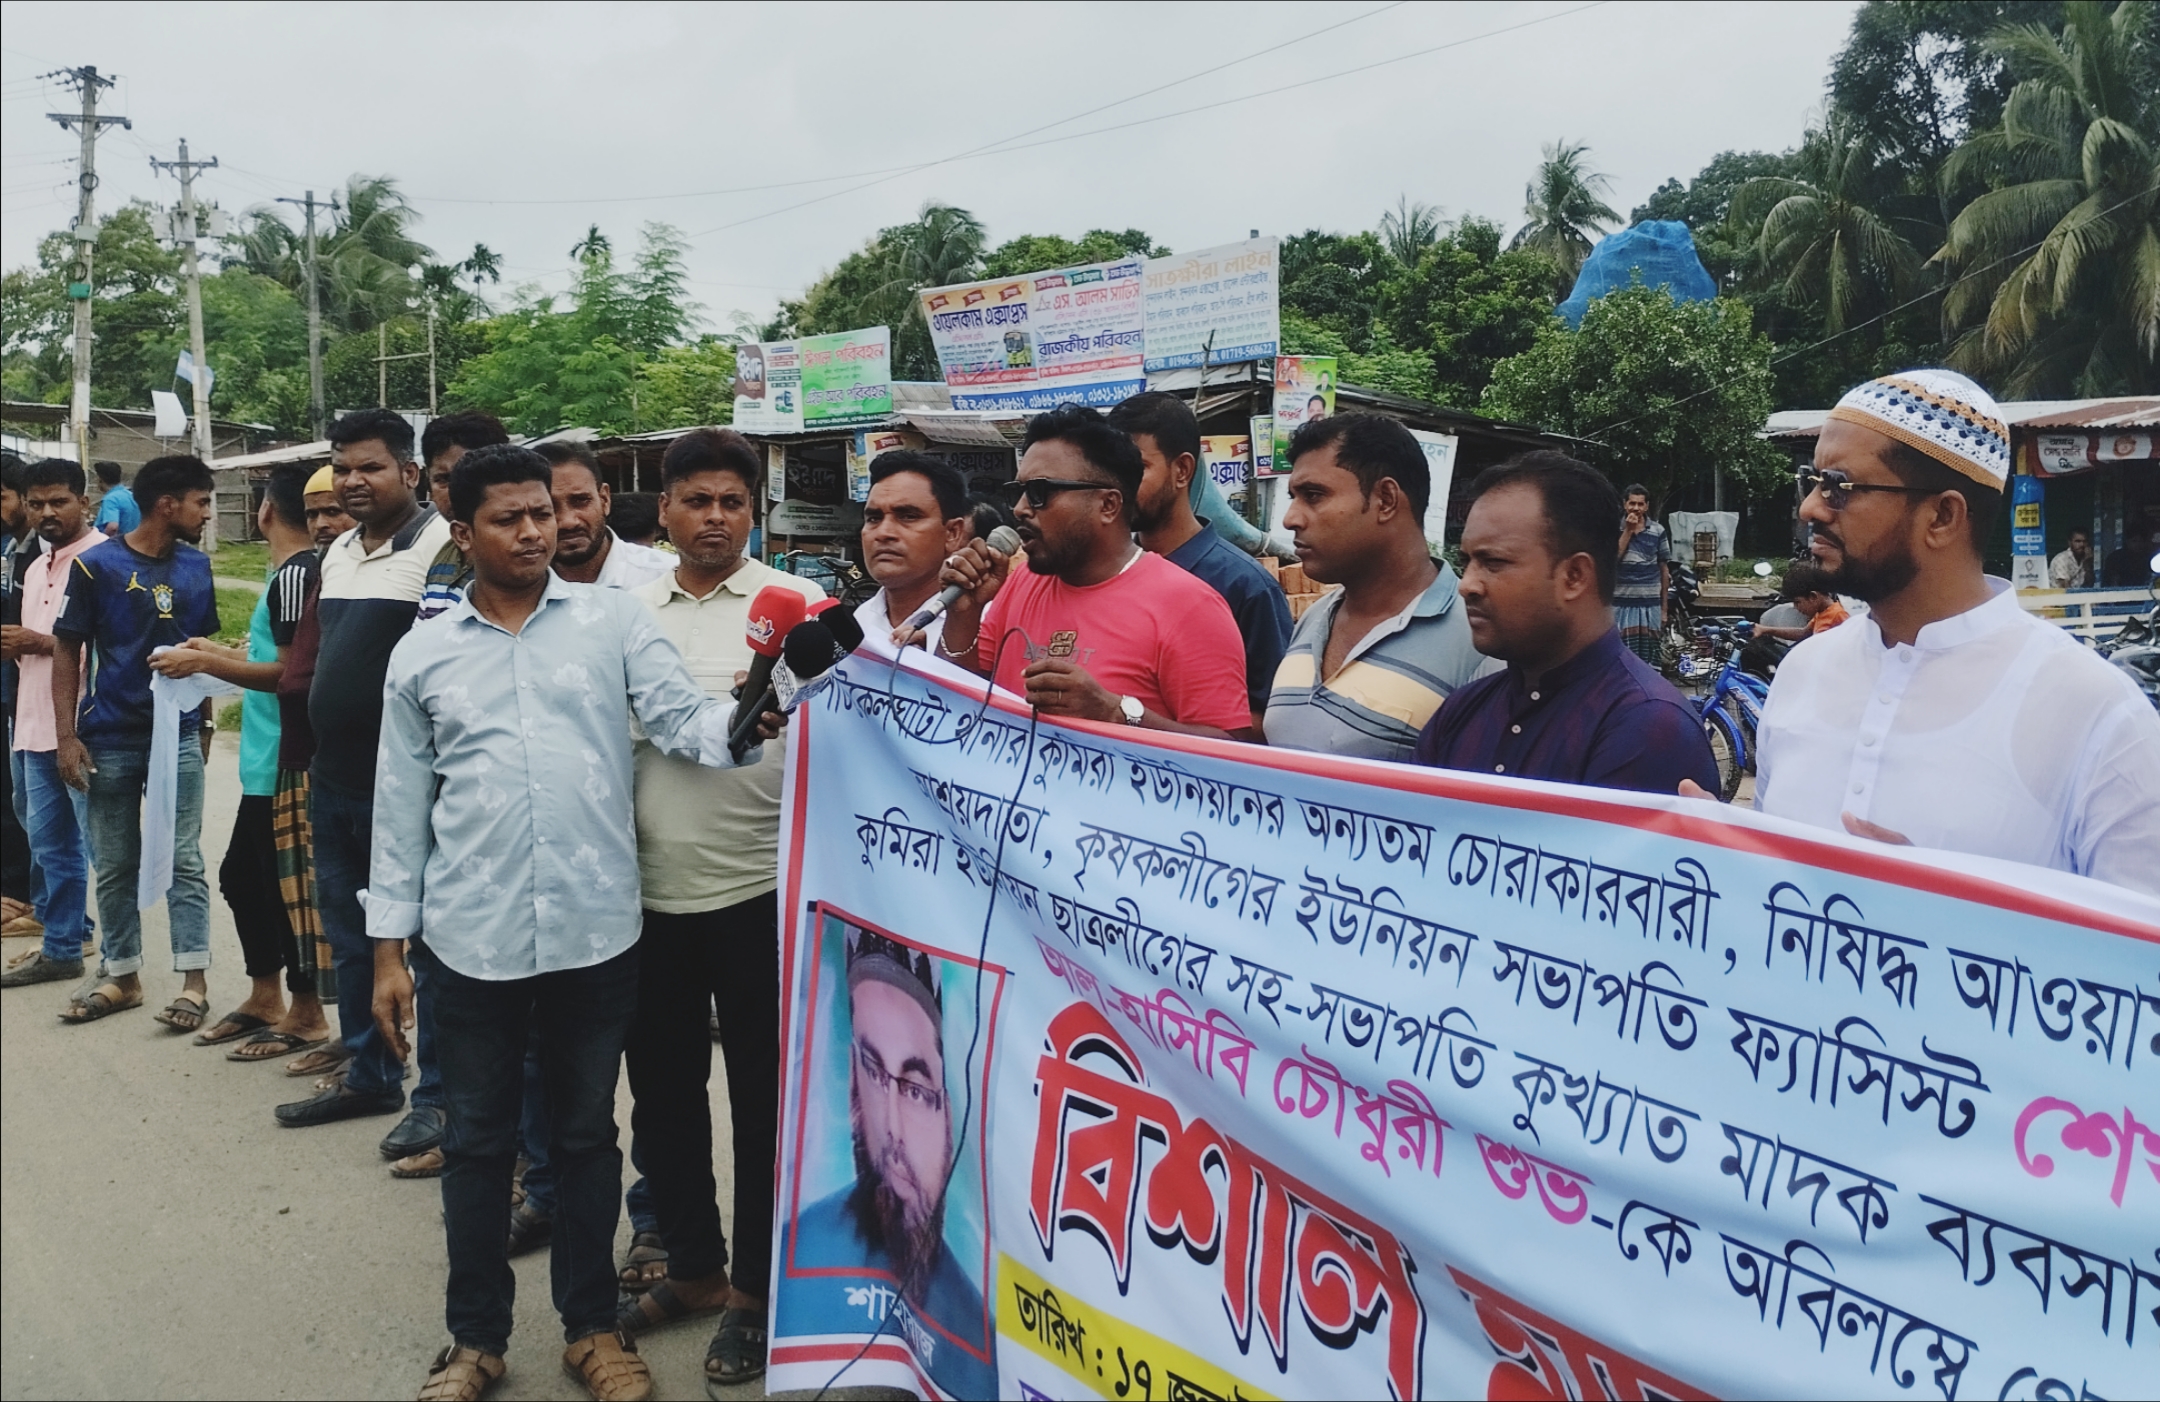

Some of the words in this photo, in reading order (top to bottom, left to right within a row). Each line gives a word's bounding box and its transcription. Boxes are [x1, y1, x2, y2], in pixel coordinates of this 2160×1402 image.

[1146, 259, 1218, 288] সাতক্ষীরা
[1224, 251, 1272, 273] লাইন
[985, 302, 1028, 326] এক্সপ্রেস
[1075, 288, 1108, 307] আলম
[835, 341, 885, 363] পরিবহন
[1038, 334, 1090, 357] রাজকীয়
[1093, 329, 1141, 350] পরিবহন
[846, 382, 887, 401] পরিবহন
[955, 710, 1030, 768] থানার
[1124, 752, 1286, 839] ইউনিয়নের
[1298, 796, 1436, 878] অন্যতম
[1763, 881, 1929, 1010] নিষিদ্ধ
[1075, 821, 1286, 927] কৃষকলীগের
[1295, 866, 1478, 988] ইউনিয়ন
[1492, 960, 1708, 1051] সভাপতি
[1727, 1015, 1992, 1140] ফ্যাসিস্ট
[854, 806, 945, 876] কুমিরা
[1047, 892, 1218, 997] ছাত্রলীগের
[1227, 955, 1498, 1089] সহ-সভাপতি
[1512, 1050, 1703, 1163] কুখ্যাত
[1719, 1121, 1899, 1245] মাদক
[1917, 1191, 2160, 1350] ব্যবসা
[1028, 1000, 1428, 1402] বিশাল
[1273, 1044, 1453, 1179] চৌধুরী
[1718, 1238, 1980, 1402] অবিলম্বে
